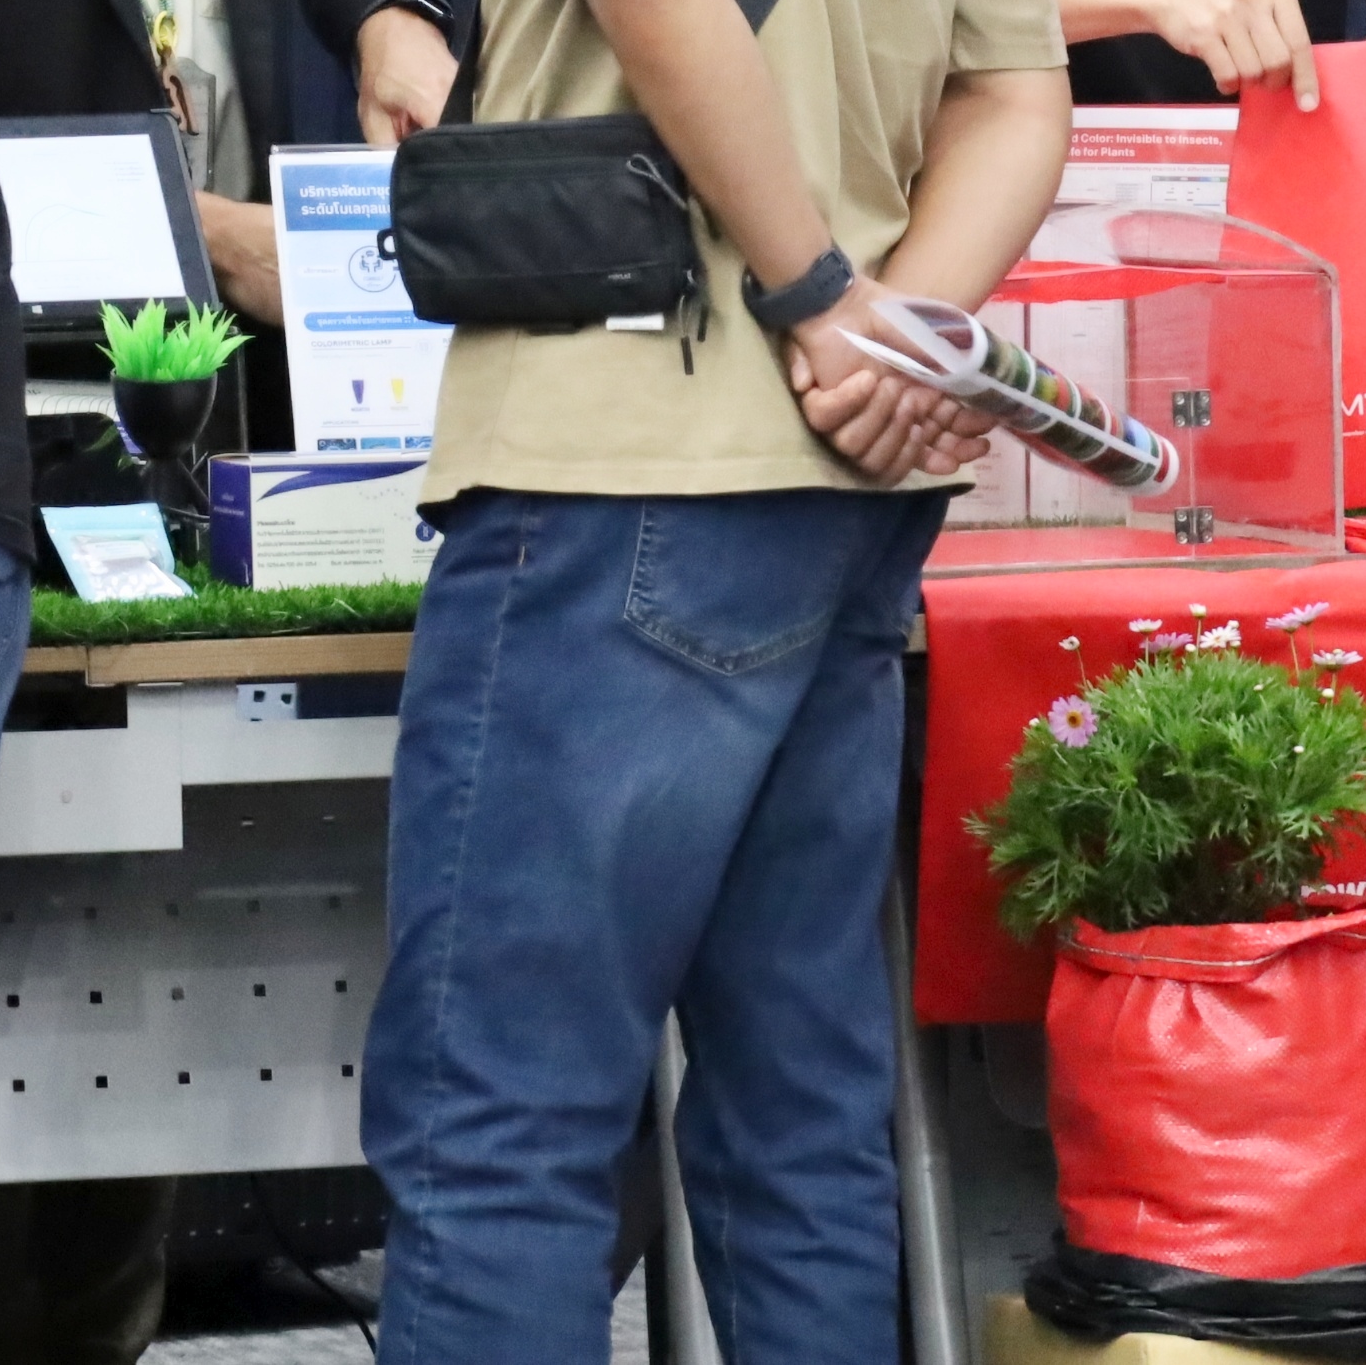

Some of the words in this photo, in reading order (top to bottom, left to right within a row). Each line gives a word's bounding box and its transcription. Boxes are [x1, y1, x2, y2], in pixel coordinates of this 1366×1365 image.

[1081, 134, 1114, 144] Color:
[1116, 134, 1162, 144] Invisible
[1165, 136, 1176, 144] to
[1179, 135, 1223, 146] Insects,
[1083, 147, 1098, 157] for
[1101, 147, 1135, 157] Plants
[311, 340, 369, 348] COLORIMETRIC
